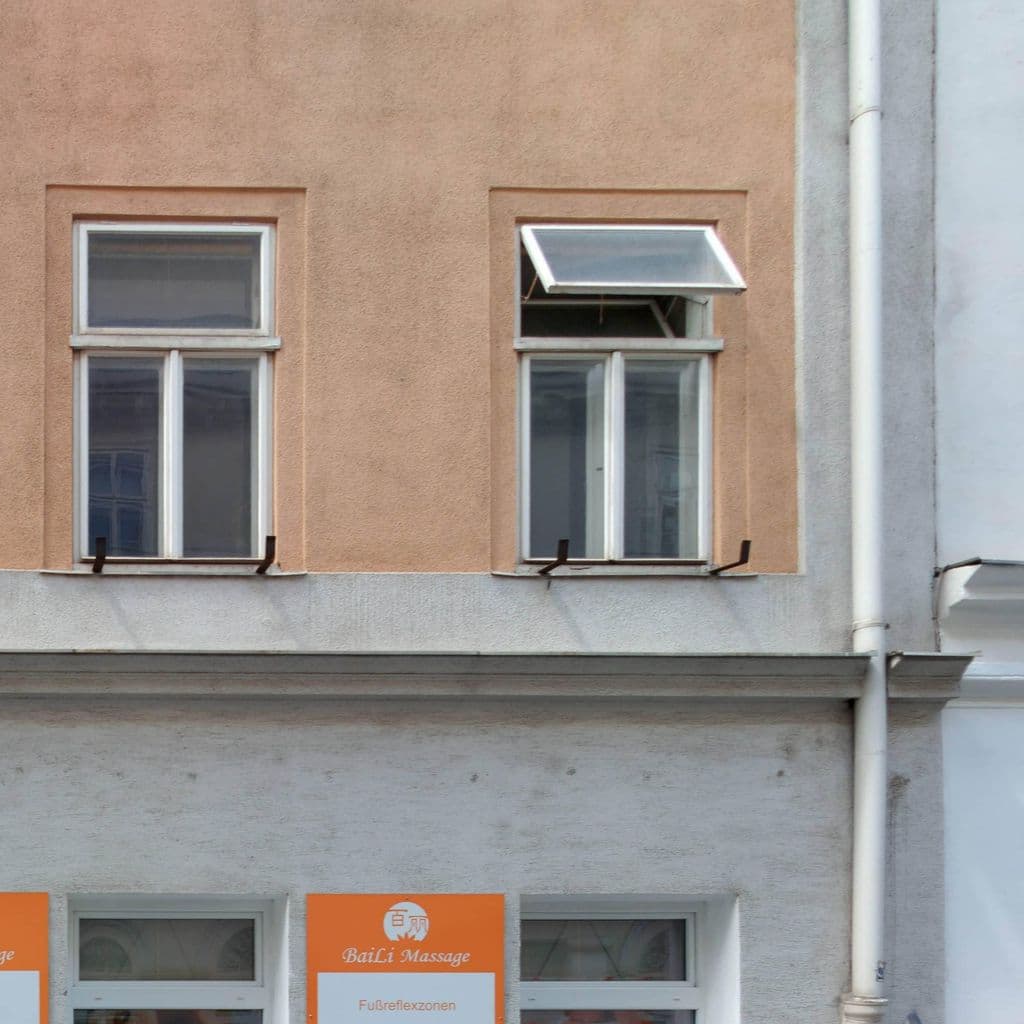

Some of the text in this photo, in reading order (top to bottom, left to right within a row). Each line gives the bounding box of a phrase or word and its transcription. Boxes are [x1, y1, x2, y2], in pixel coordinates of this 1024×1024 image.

[342, 947, 471, 967] BaiLi Massage
[359, 999, 456, 1012] Fußreflexzonen
